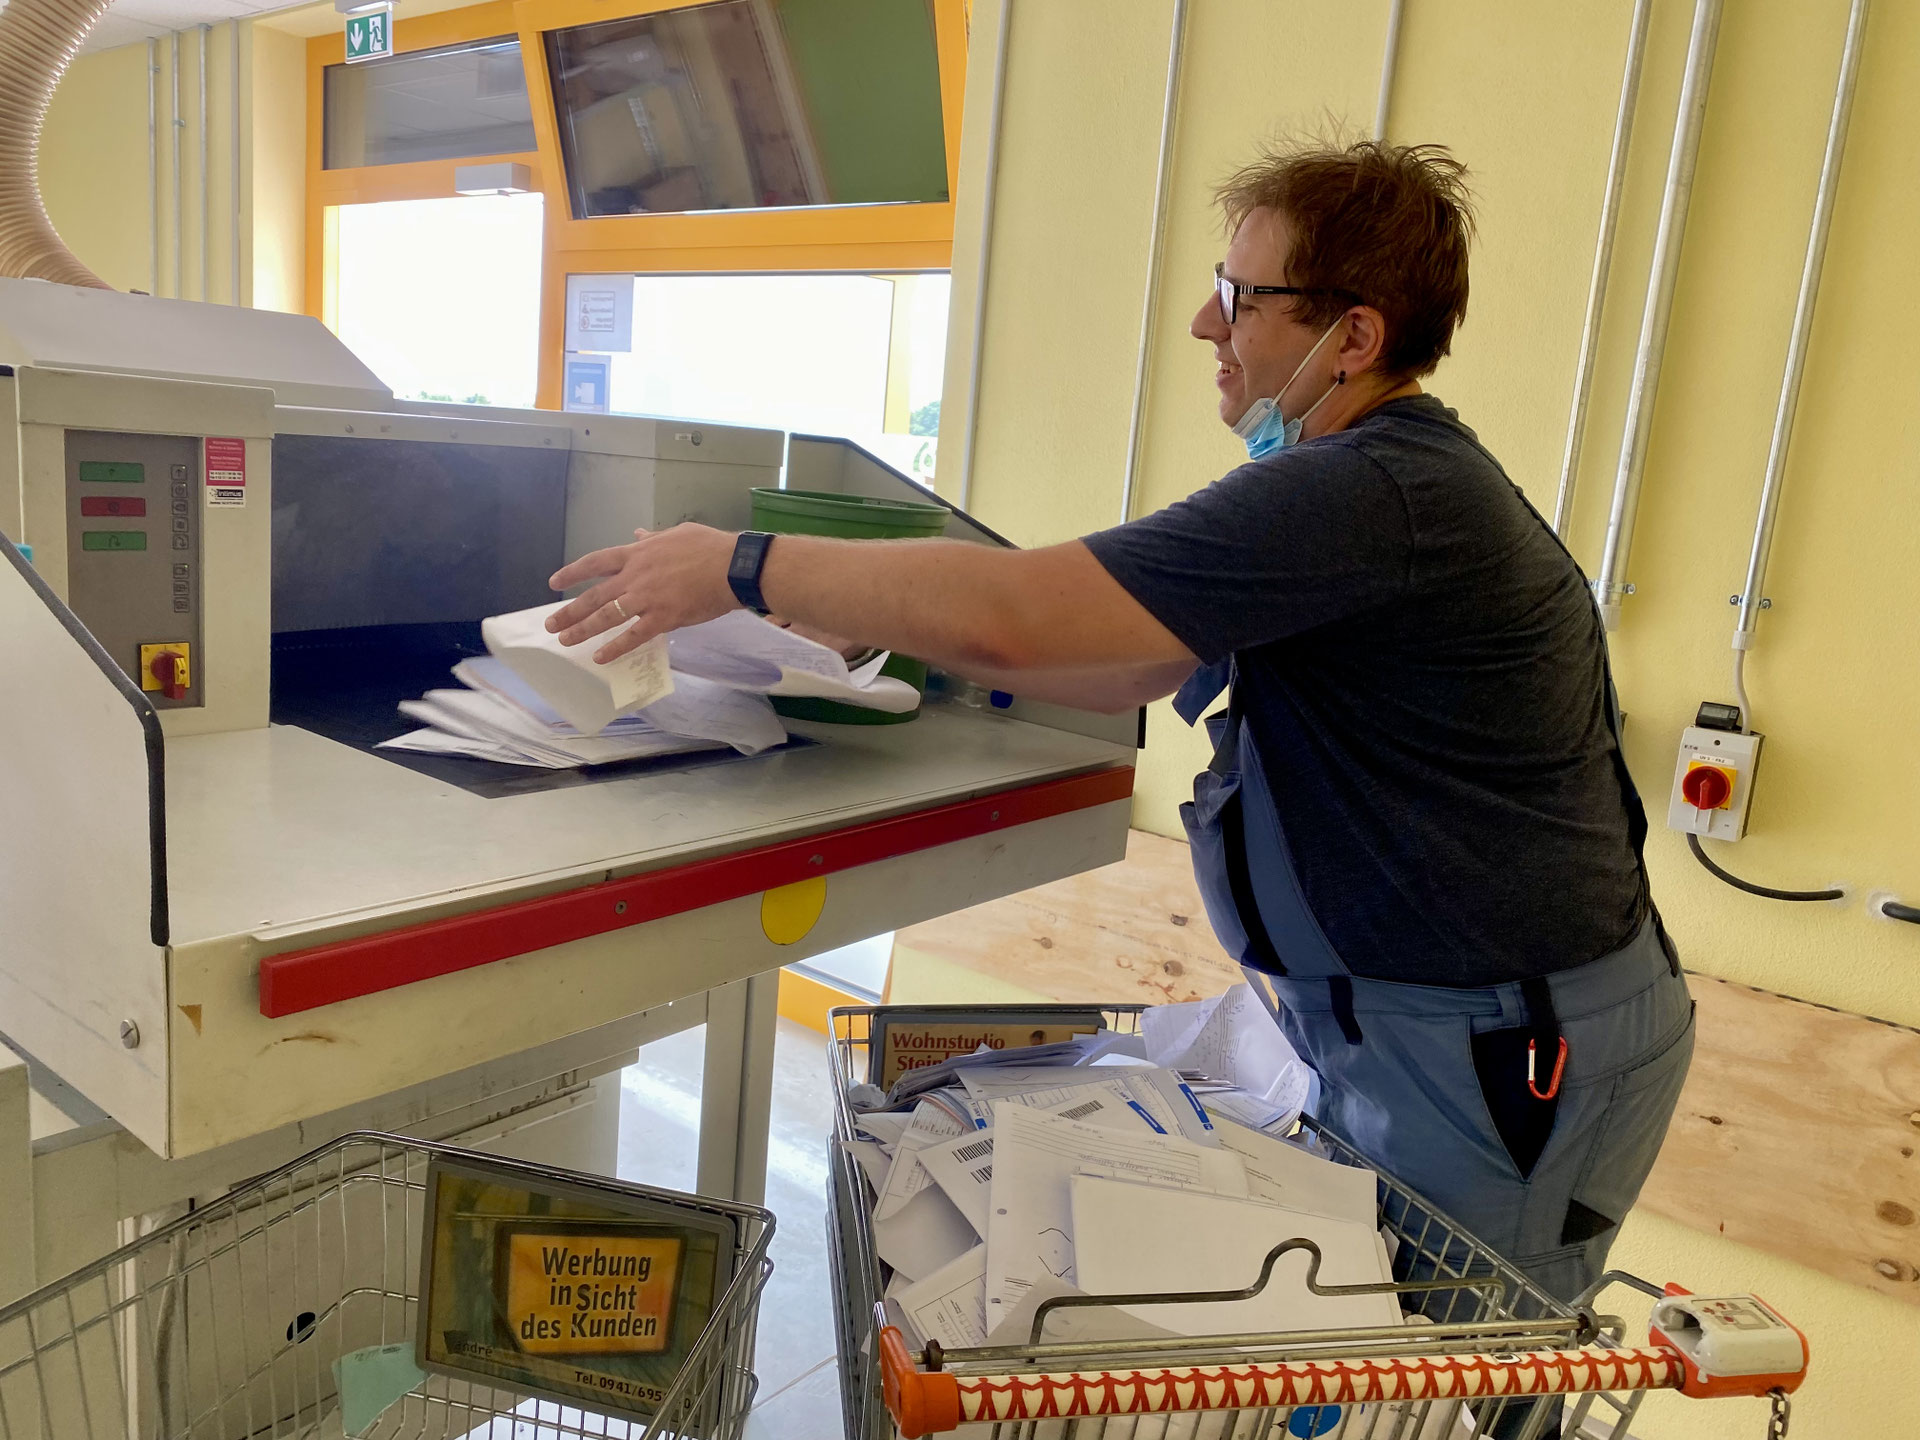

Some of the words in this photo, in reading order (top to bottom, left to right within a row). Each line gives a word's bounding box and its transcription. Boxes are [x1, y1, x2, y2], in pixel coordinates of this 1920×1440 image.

[892, 1032, 1005, 1049] Wohnstudio
[542, 1247, 652, 1282] Werbung
[549, 1277, 572, 1307] in
[577, 1283, 638, 1312] Sicht
[520, 1313, 562, 1341] des
[571, 1312, 657, 1339] Kunden
[574, 1370, 598, 1387] Tel.
